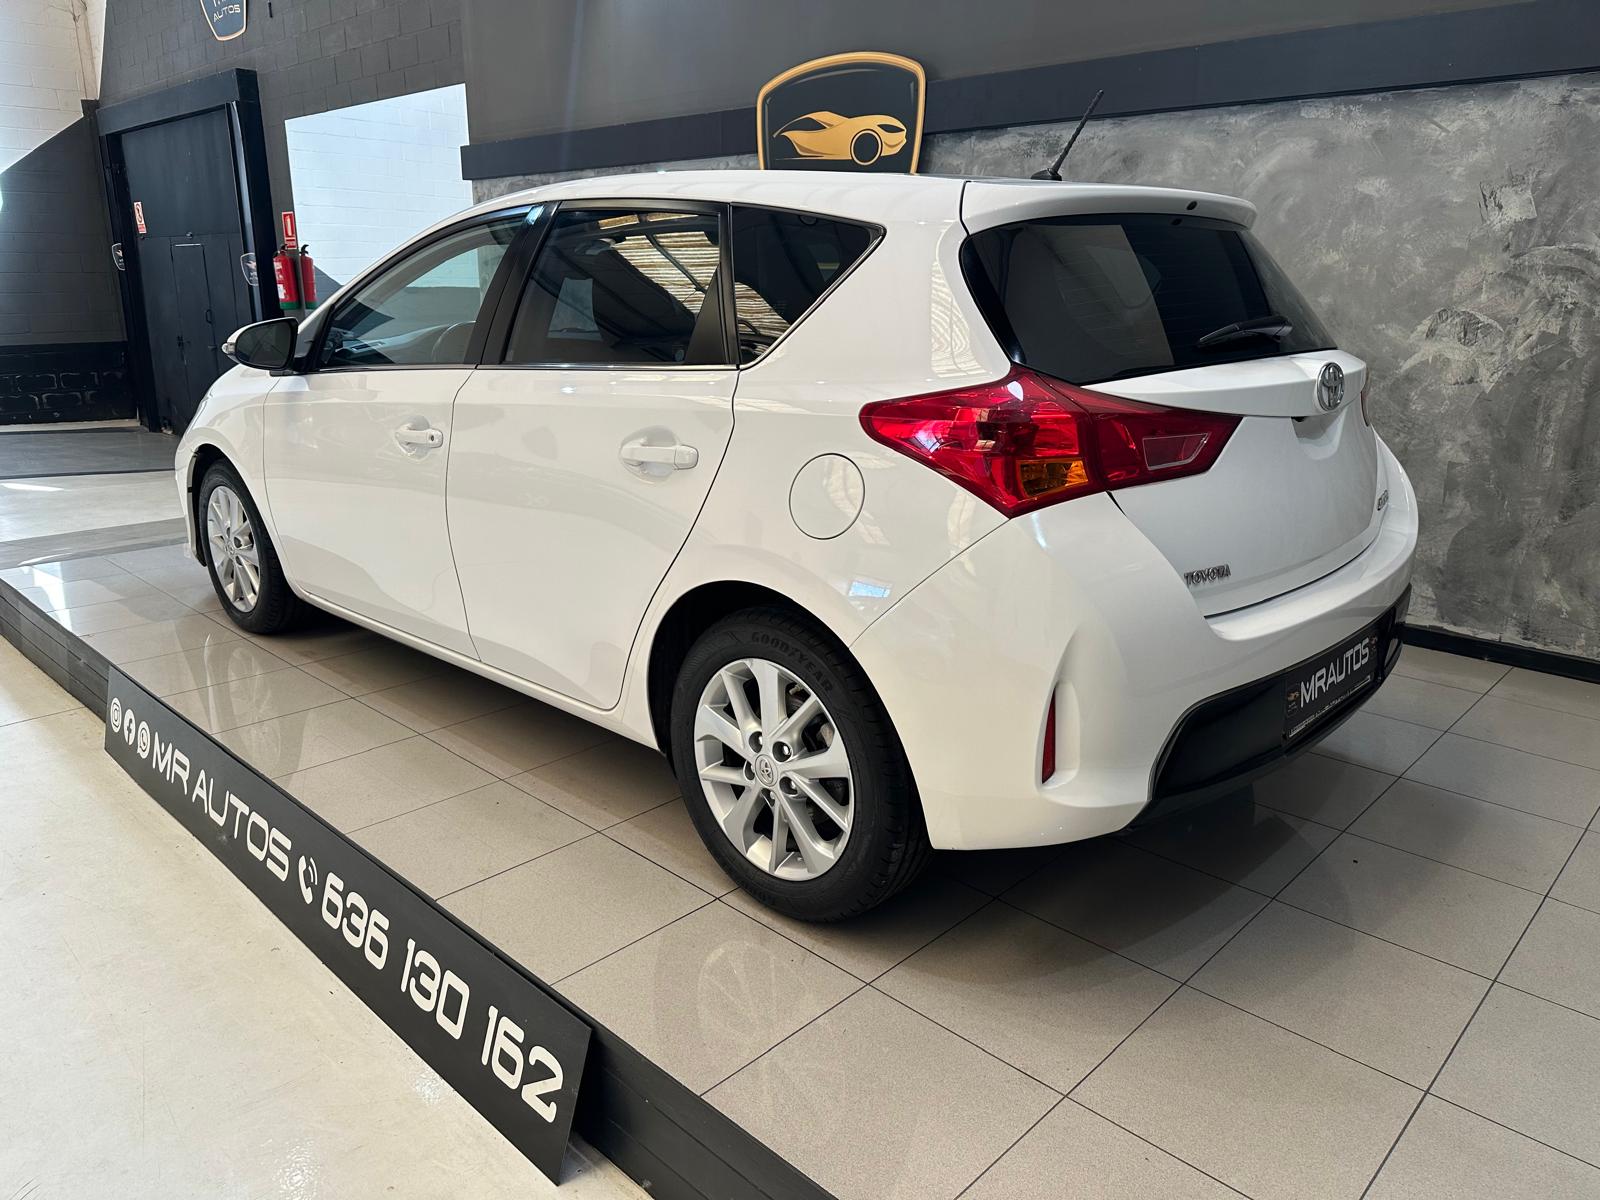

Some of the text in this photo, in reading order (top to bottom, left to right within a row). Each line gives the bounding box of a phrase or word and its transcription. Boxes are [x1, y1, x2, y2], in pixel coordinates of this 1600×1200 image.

[213, 4, 241, 23] AUTOS
[1184, 564, 1231, 587] TOYOTA
[751, 631, 835, 692] GOODYEAR
[152, 731, 564, 1123] MR AUTOS 636 130 162
